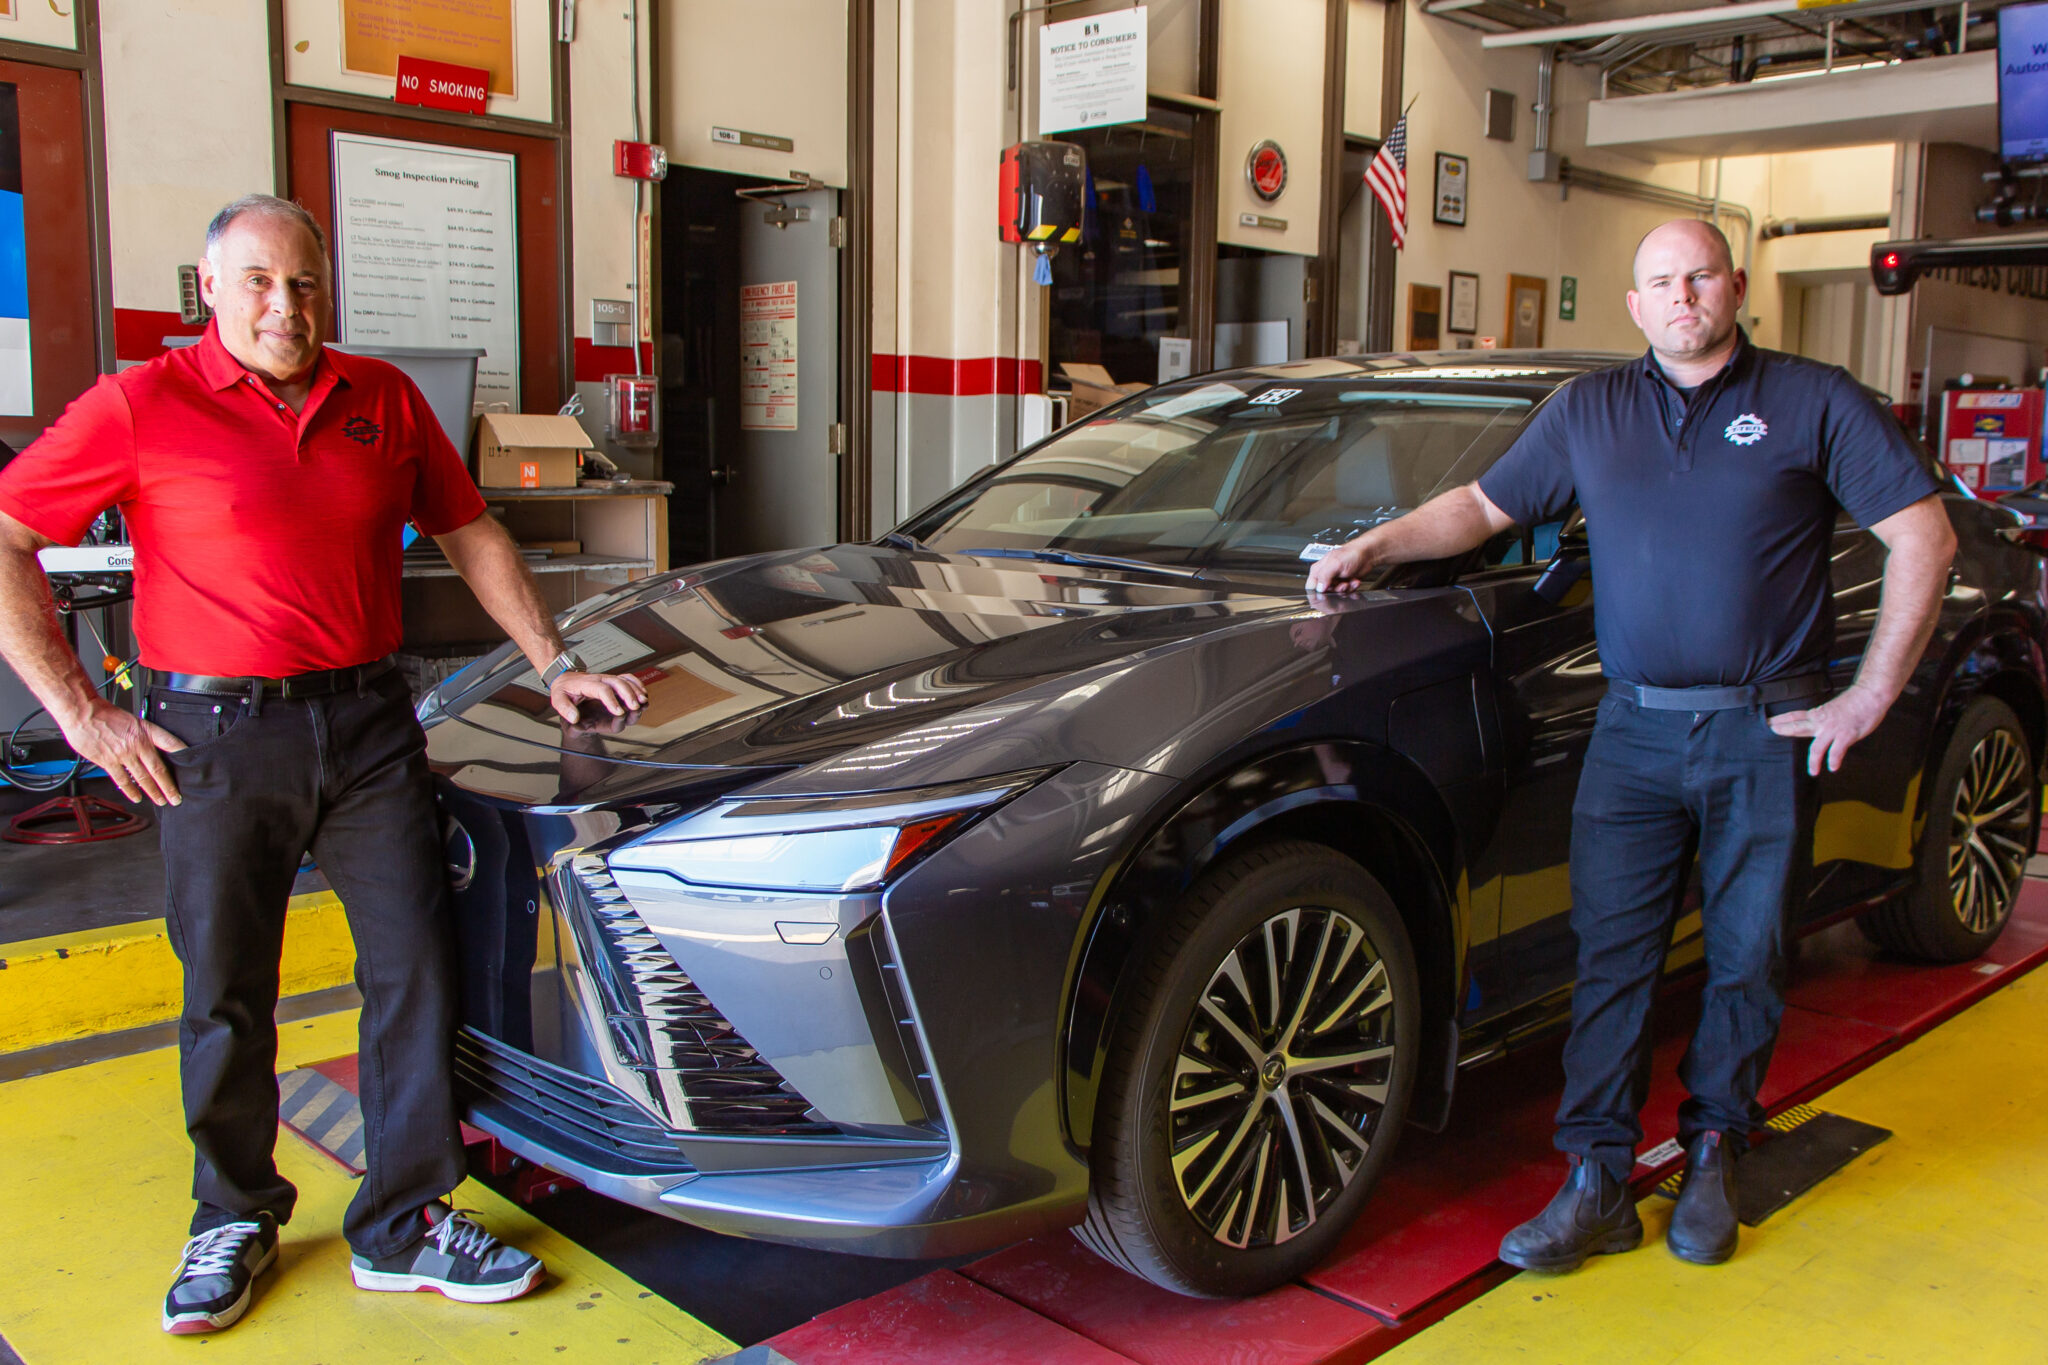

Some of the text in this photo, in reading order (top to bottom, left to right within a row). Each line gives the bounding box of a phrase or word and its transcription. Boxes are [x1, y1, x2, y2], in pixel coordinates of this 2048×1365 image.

[1050, 43, 1076, 55] NOTICE
[1078, 41, 1088, 50] TO
[1090, 32, 1137, 47] CONSUMERS
[401, 74, 485, 100] NO SMOKING
[374, 168, 479, 189] Smog Inspection Pricing
[772, 284, 785, 295] FIRST
[787, 283, 796, 293] AID
[597, 303, 625, 314] 105-G
